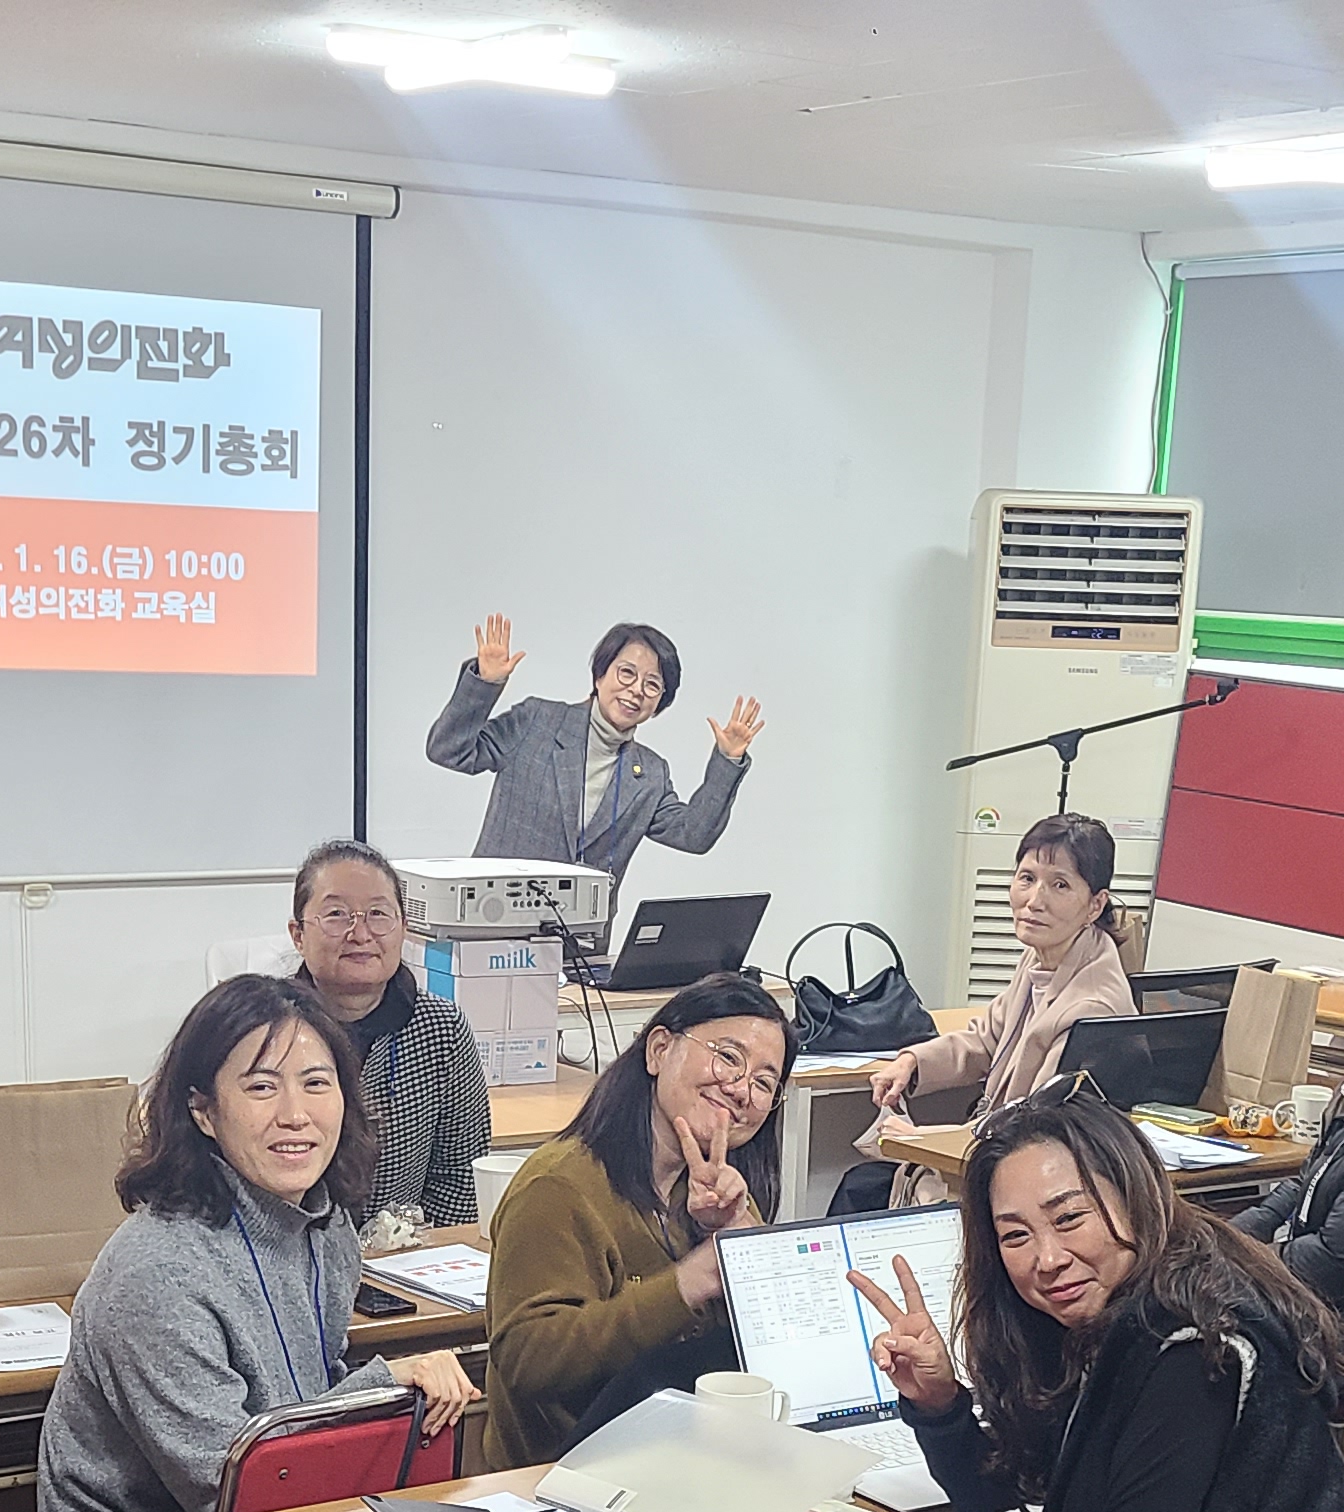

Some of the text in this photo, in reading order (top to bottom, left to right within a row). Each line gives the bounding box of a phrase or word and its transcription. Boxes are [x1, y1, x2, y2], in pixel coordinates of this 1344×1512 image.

[125, 418, 299, 479] 정기총회
[15, 542, 42, 573] 1.
[165, 549, 245, 582] 10:00
[131, 589, 217, 624] 교육실
[489, 947, 537, 969] miilk
